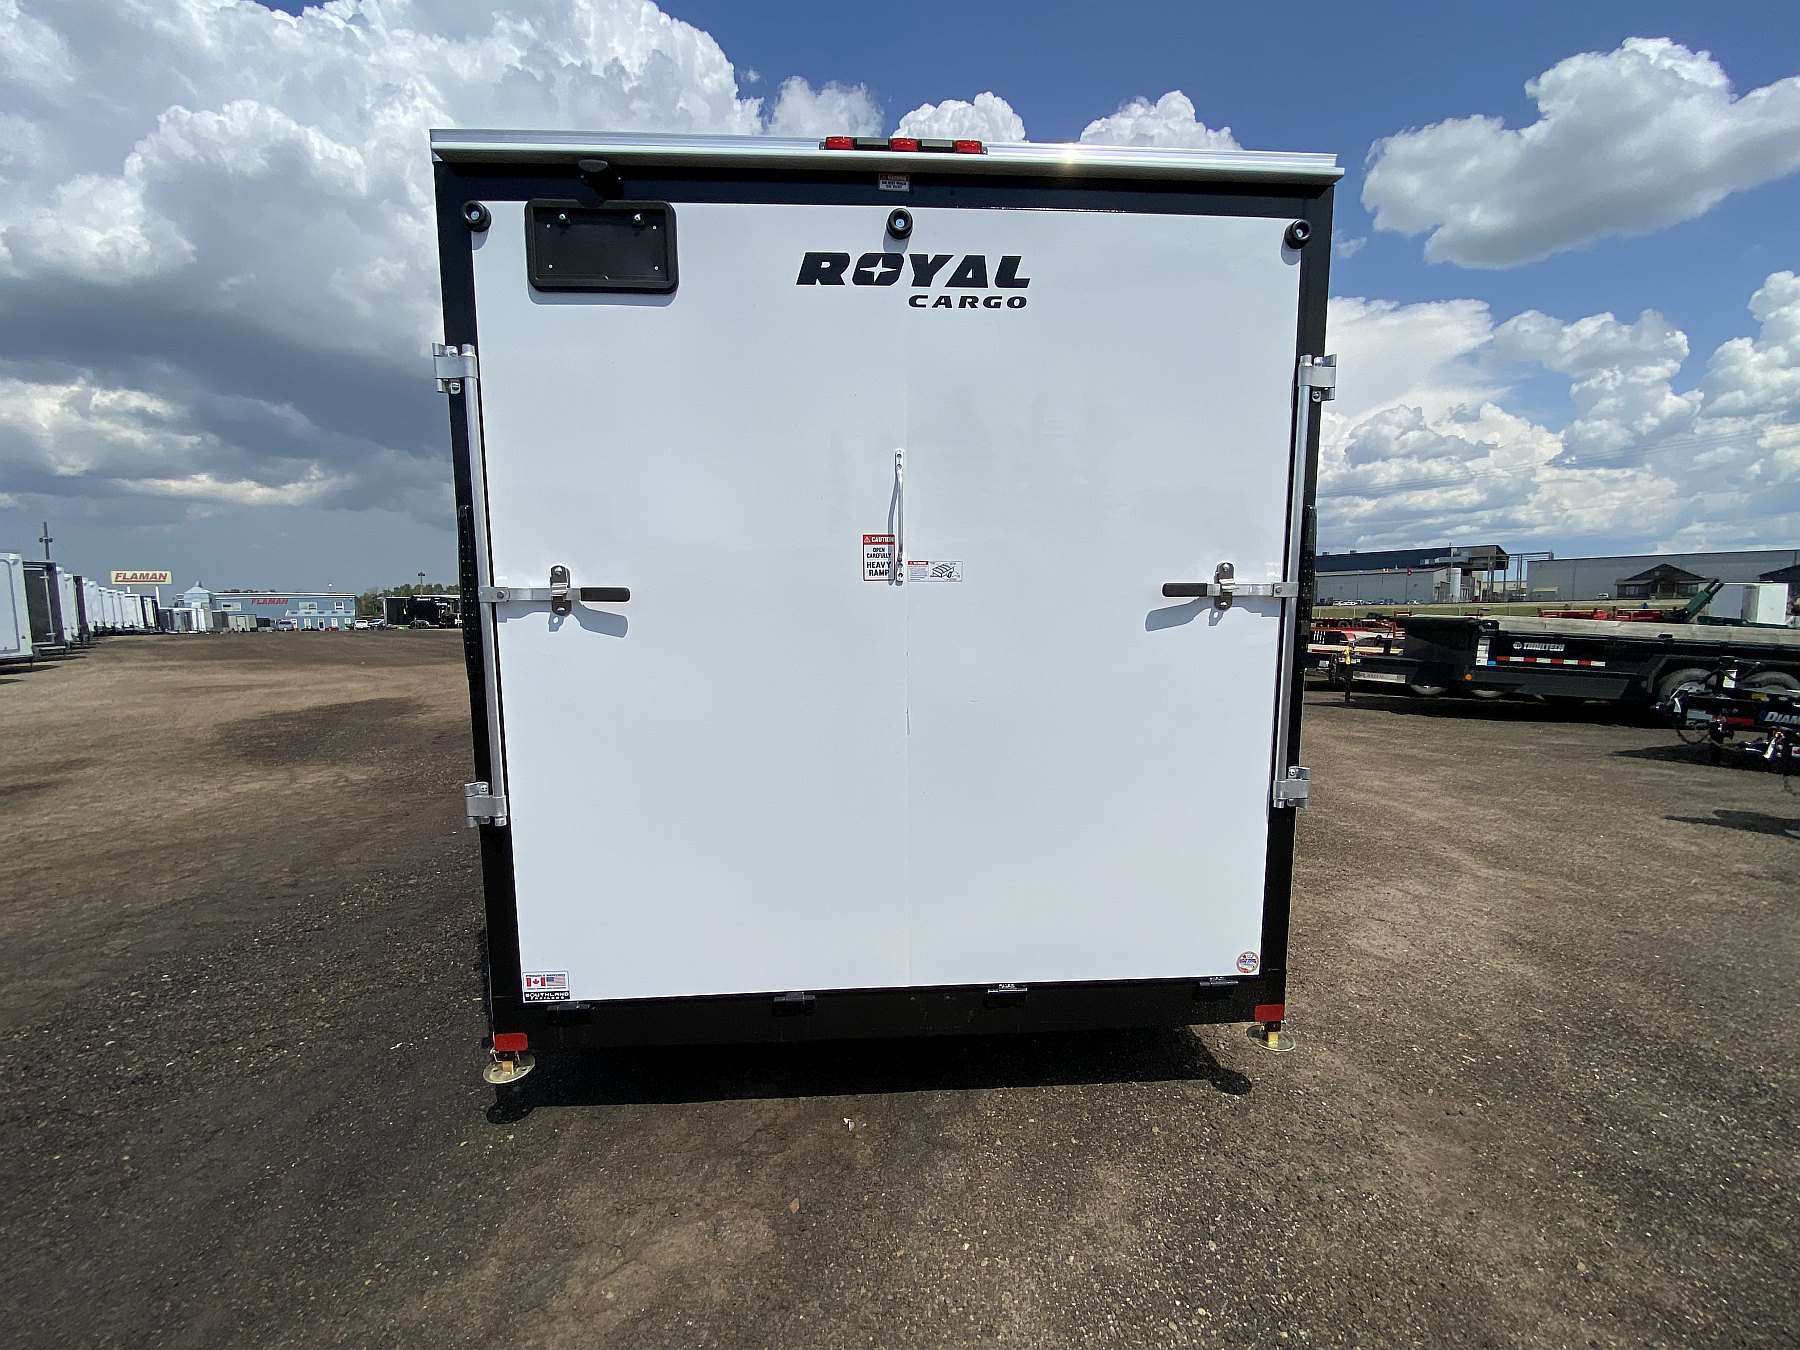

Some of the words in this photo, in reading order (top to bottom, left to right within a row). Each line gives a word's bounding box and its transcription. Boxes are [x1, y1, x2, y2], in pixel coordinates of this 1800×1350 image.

[796, 252, 1031, 289] ROYAL
[908, 294, 1028, 309] CARGO
[866, 561, 892, 569] HEAVY
[114, 572, 168, 581] FLAMAN
[868, 569, 890, 577] RAMP
[250, 597, 289, 605] FLAMAN
